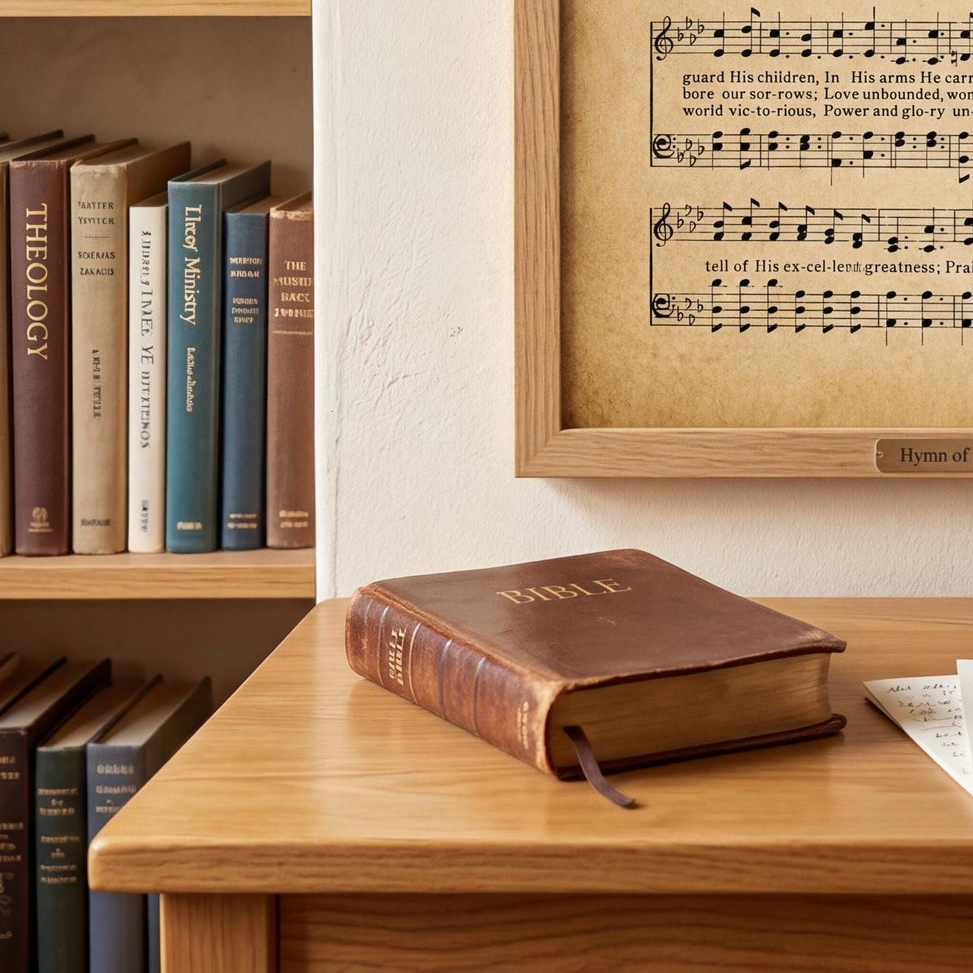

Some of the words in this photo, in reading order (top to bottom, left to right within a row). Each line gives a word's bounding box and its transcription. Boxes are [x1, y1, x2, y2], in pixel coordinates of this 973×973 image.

[682, 70, 726, 88] guard
[729, 69, 755, 84] His
[850, 70, 876, 84] His
[878, 73, 916, 84] arms
[919, 70, 942, 85] He
[682, 86, 715, 100] bore
[721, 90, 747, 100] our
[823, 86, 861, 101] Love
[861, 86, 945, 104] unbounded,
[823, 103, 872, 118] Power
[872, 103, 899, 118] and
[284, 260, 307, 271] THE
[704, 258, 729, 273] tell
[733, 259, 750, 273] of
[754, 259, 780, 273] His
[862, 261, 941, 277] greatness;
[25, 202, 49, 360] THEOLOGY
[180, 257, 202, 326] Ministry
[899, 446, 948, 467] Hymn
[951, 446, 972, 463] of
[495, 578, 633, 605] BIBLE
